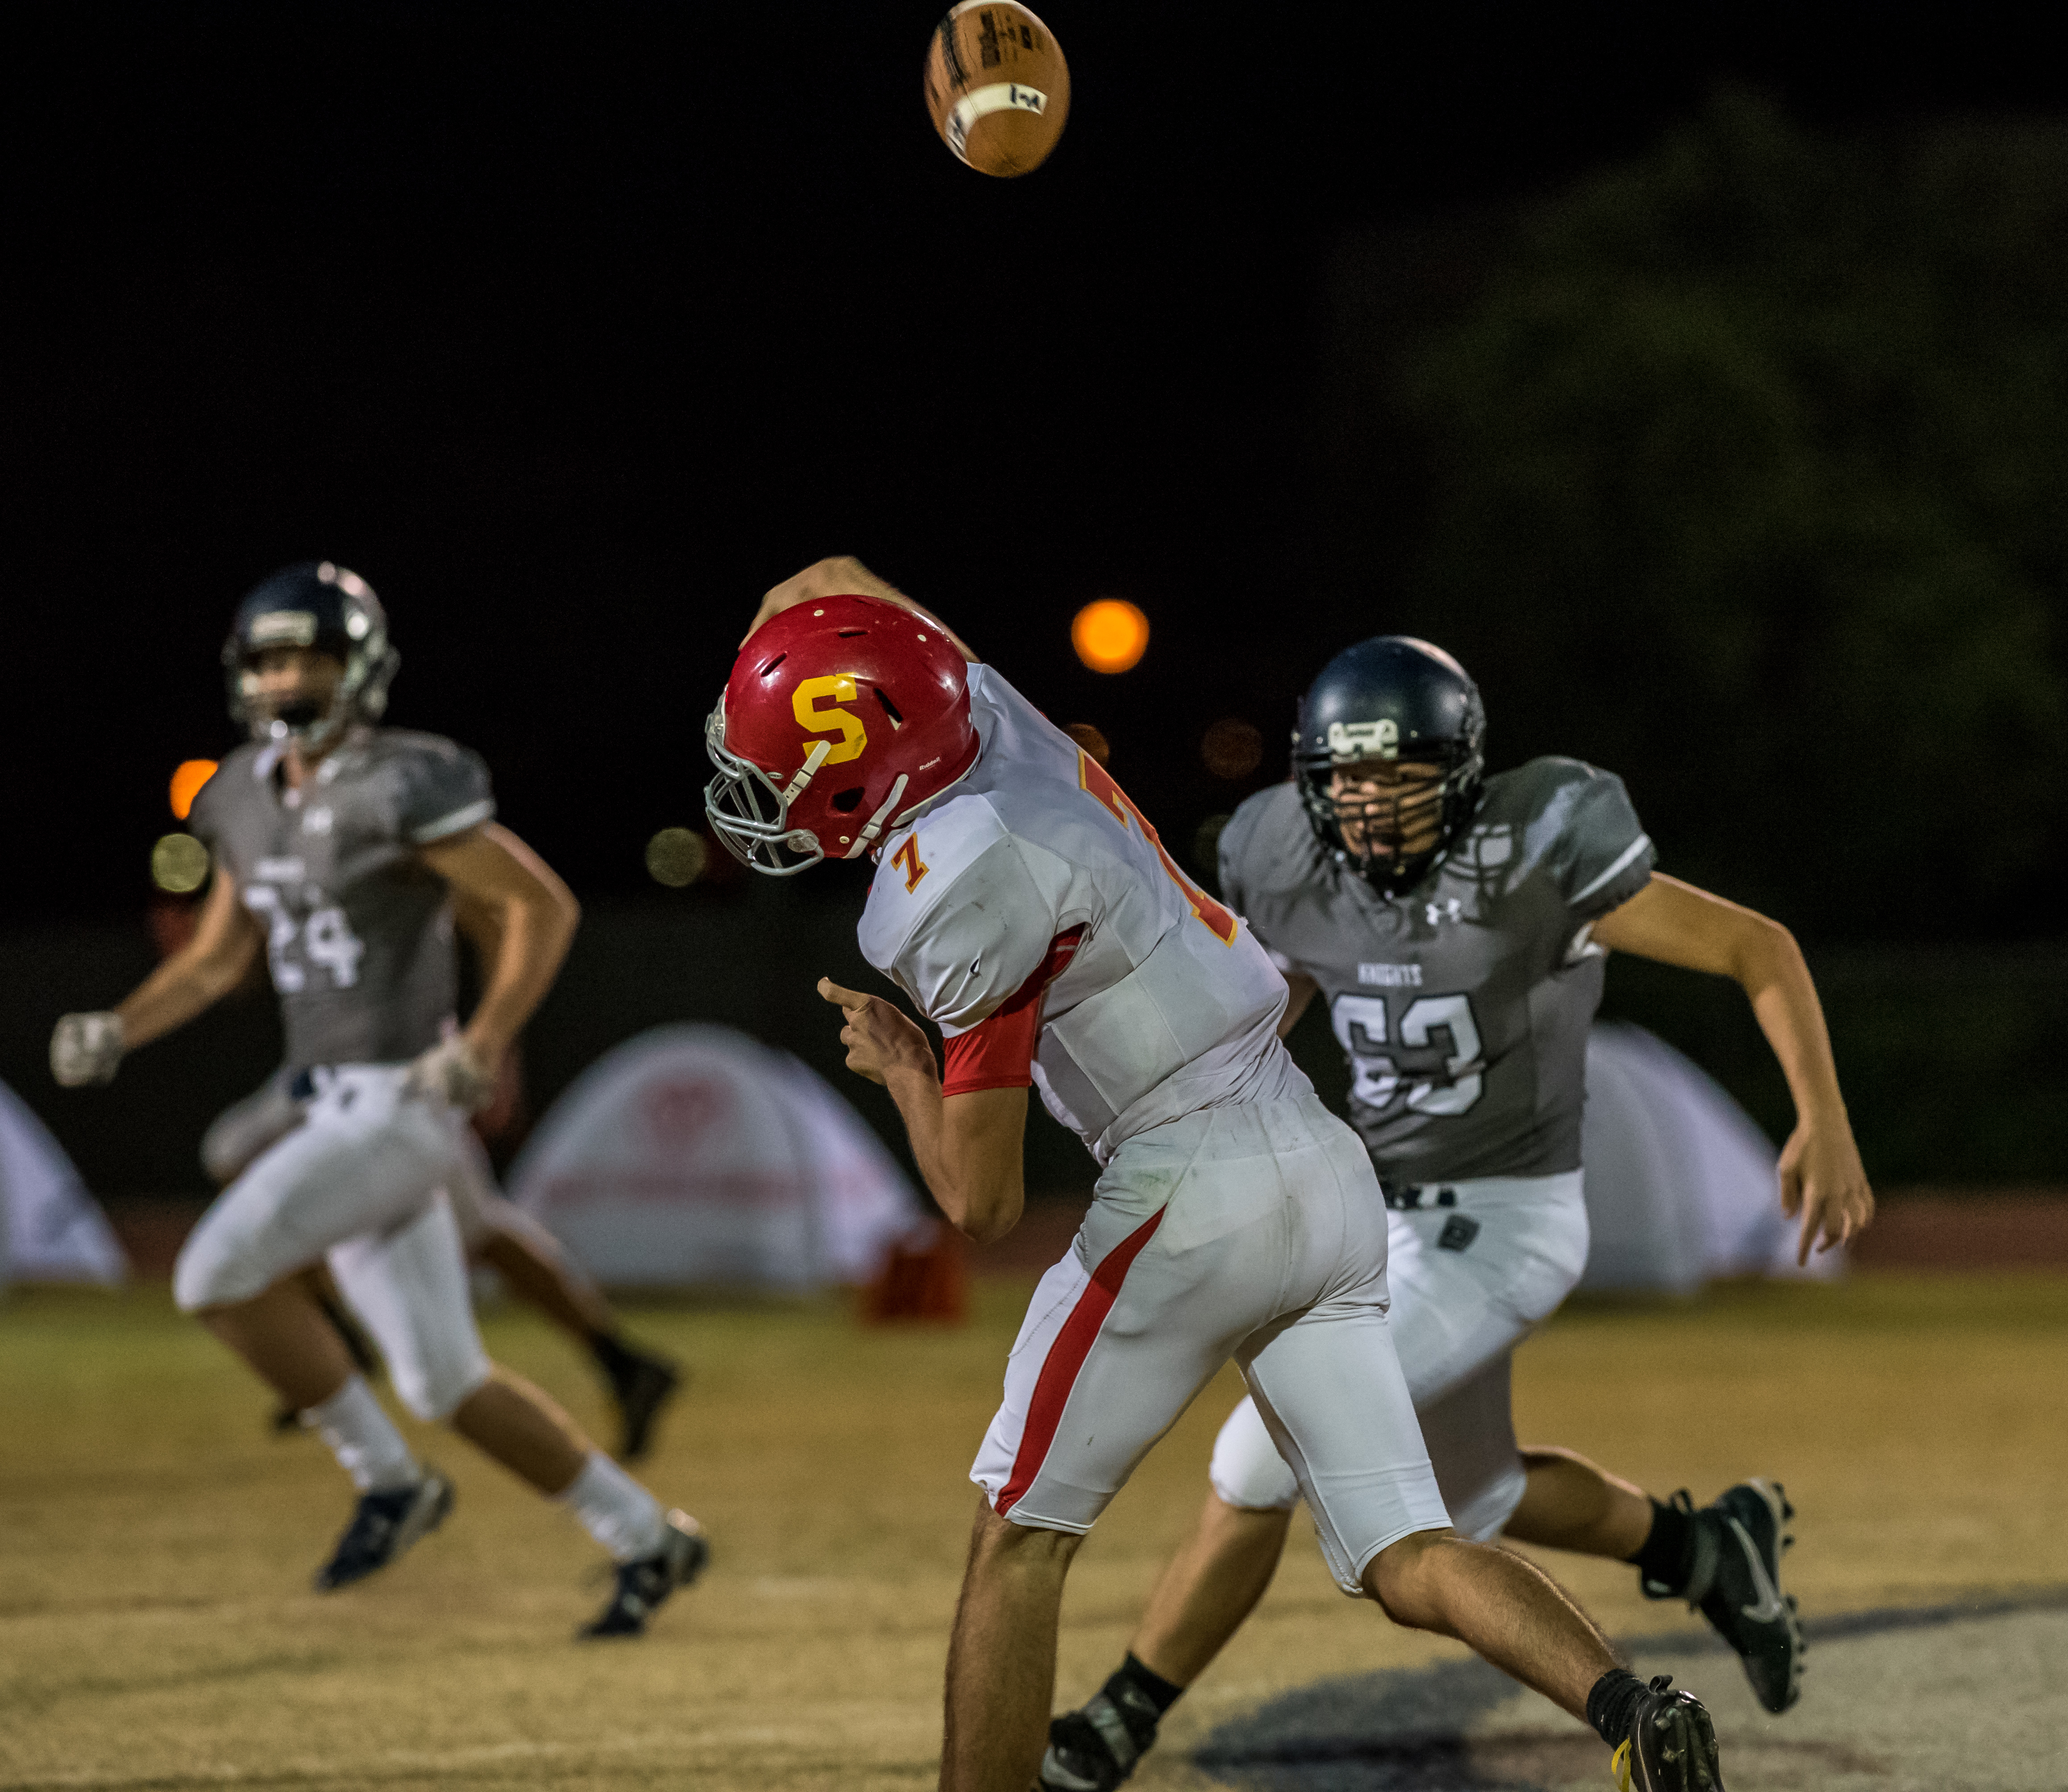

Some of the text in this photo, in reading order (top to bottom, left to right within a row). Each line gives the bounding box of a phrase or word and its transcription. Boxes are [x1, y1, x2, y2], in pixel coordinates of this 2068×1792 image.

[792, 672, 867, 766] S
[891, 832, 930, 895] 7
[1333, 992, 1483, 1116] 63
